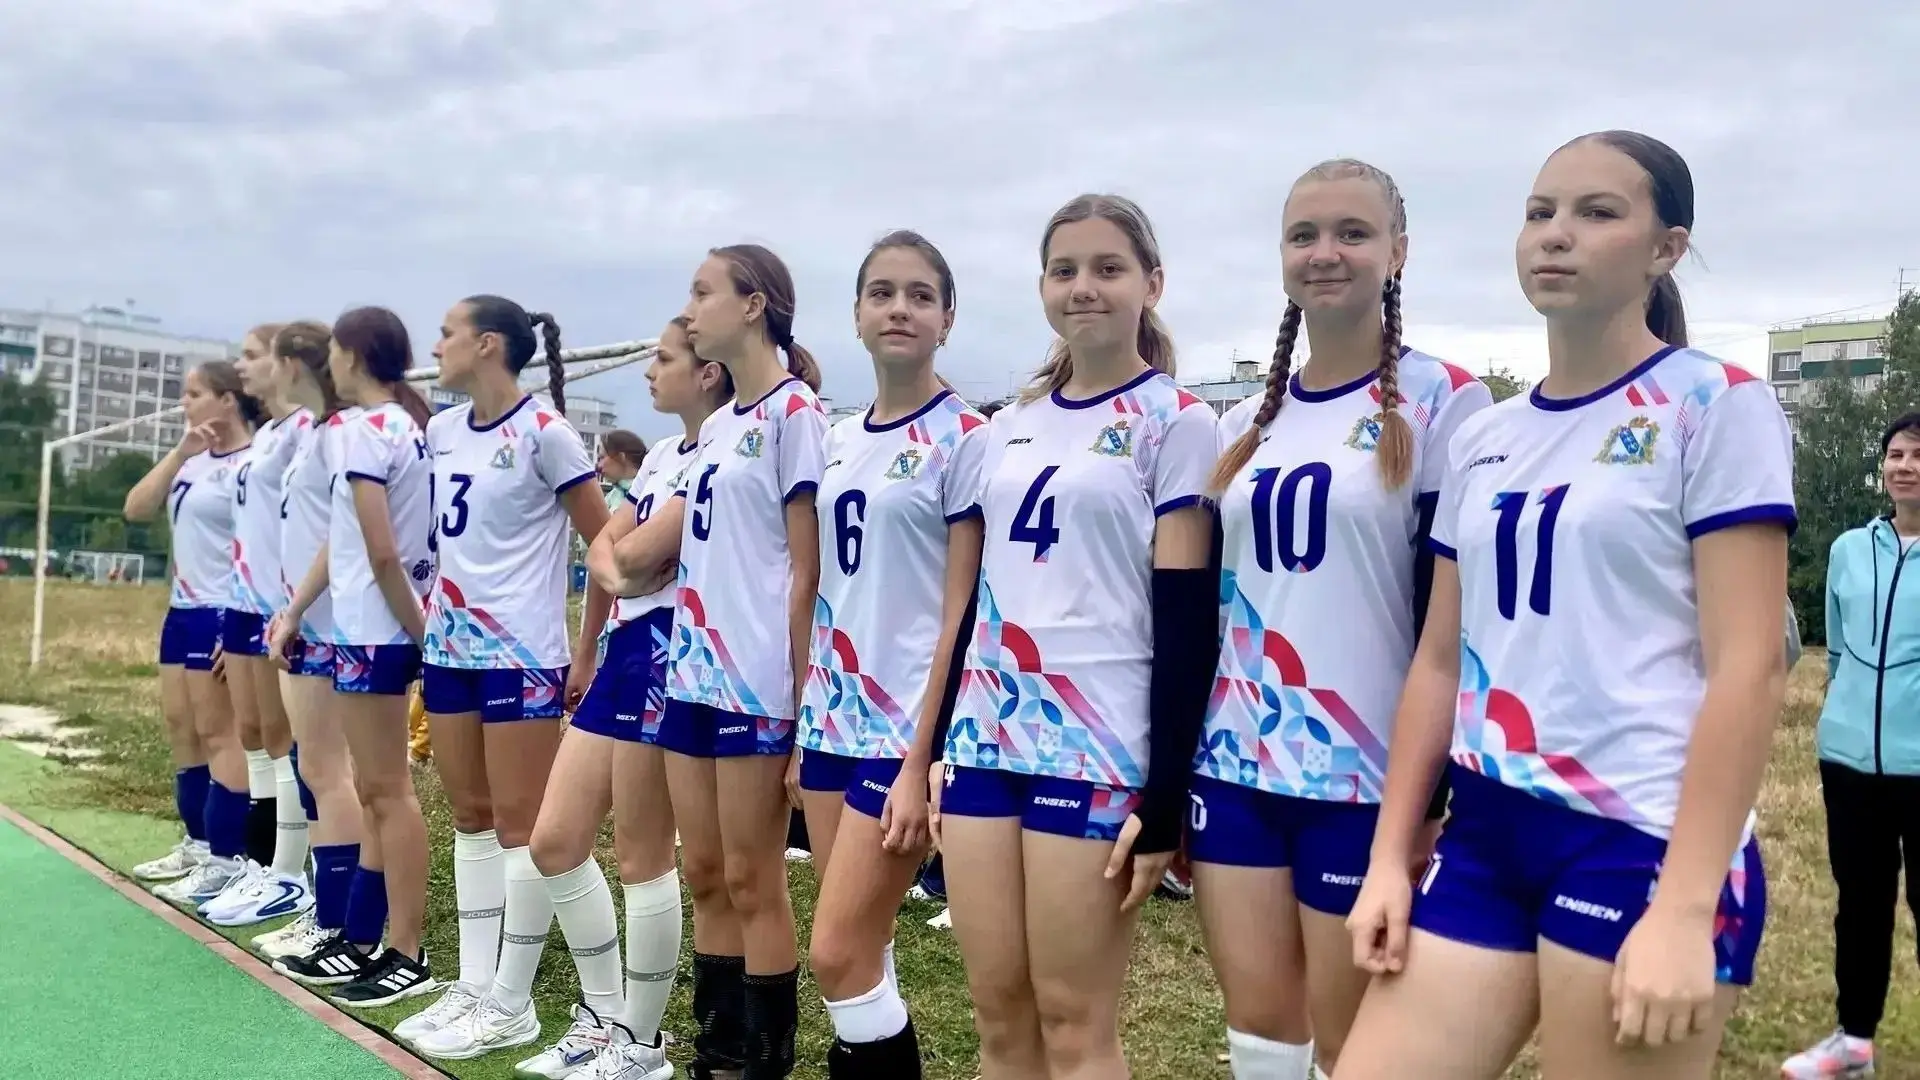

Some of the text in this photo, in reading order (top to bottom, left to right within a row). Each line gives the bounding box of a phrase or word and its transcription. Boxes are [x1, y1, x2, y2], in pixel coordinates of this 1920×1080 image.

[172, 480, 193, 525] 7
[442, 473, 475, 538] 3
[692, 463, 720, 542] 5
[834, 489, 866, 577] 6
[1009, 465, 1061, 563] 4
[1248, 461, 1332, 574] 10
[1489, 482, 1571, 621] 11
[862, 779, 891, 794] ENS
[1321, 872, 1363, 886] ENSE
[1554, 893, 1624, 922] ENSEN
